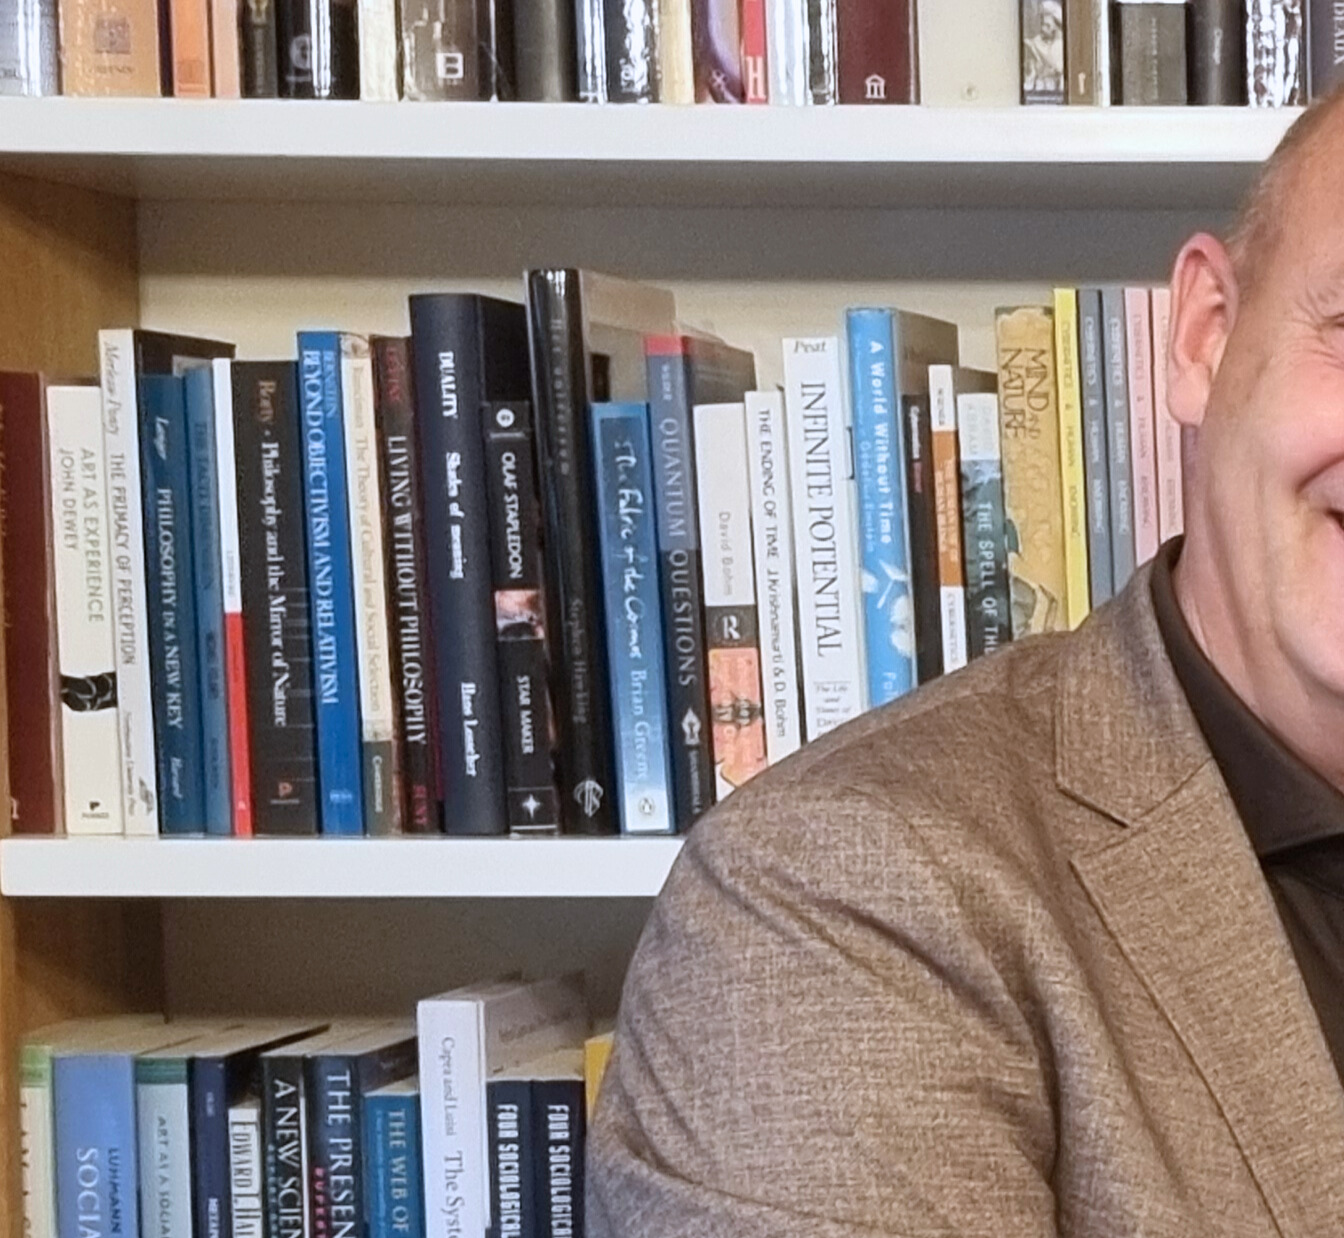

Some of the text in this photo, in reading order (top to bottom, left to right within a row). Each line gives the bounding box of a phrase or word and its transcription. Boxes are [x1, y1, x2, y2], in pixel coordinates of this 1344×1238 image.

[1003, 348, 1021, 438] NATURE
[1025, 349, 1049, 412] MIND
[758, 408, 778, 557] THE ENDING OF TIME
[870, 341, 894, 545] A World Without Time
[59, 447, 78, 550] JOHN DEWEY
[81, 449, 104, 622] ART AS EXPERIENCE
[303, 350, 338, 704] BEYOND OBJECTIVISM AND RELATIVISM
[503, 452, 523, 578] OLAF STAPLEDON
[800, 382, 842, 657] INFINITE POTENTIAL
[109, 453, 136, 665] THE PRIMACY OF PERCEPTION
[258, 380, 290, 727] Rorty Philosophy and the Mirror of Nature
[388, 435, 424, 744] LIVING WITHOUT PHILOSOPHY
[660, 418, 697, 686] QUANTUM QUESTIONS
[156, 488, 183, 729] PHILOSOPHY IN A NEW KEY
[517, 675, 534, 753] STAR MAKER
[275, 1079, 293, 1099] A
[326, 1070, 352, 1126] THE
[389, 1109, 407, 1149] THE
[497, 1104, 520, 1141] FOUR
[548, 1104, 569, 1141] FOUR
[276, 1105, 298, 1167] NEW
[390, 1155, 409, 1202] WEB
[444, 1151, 465, 1191] The
[108, 1147, 122, 1233] LUHMANN
[392, 1207, 410, 1236] OF
